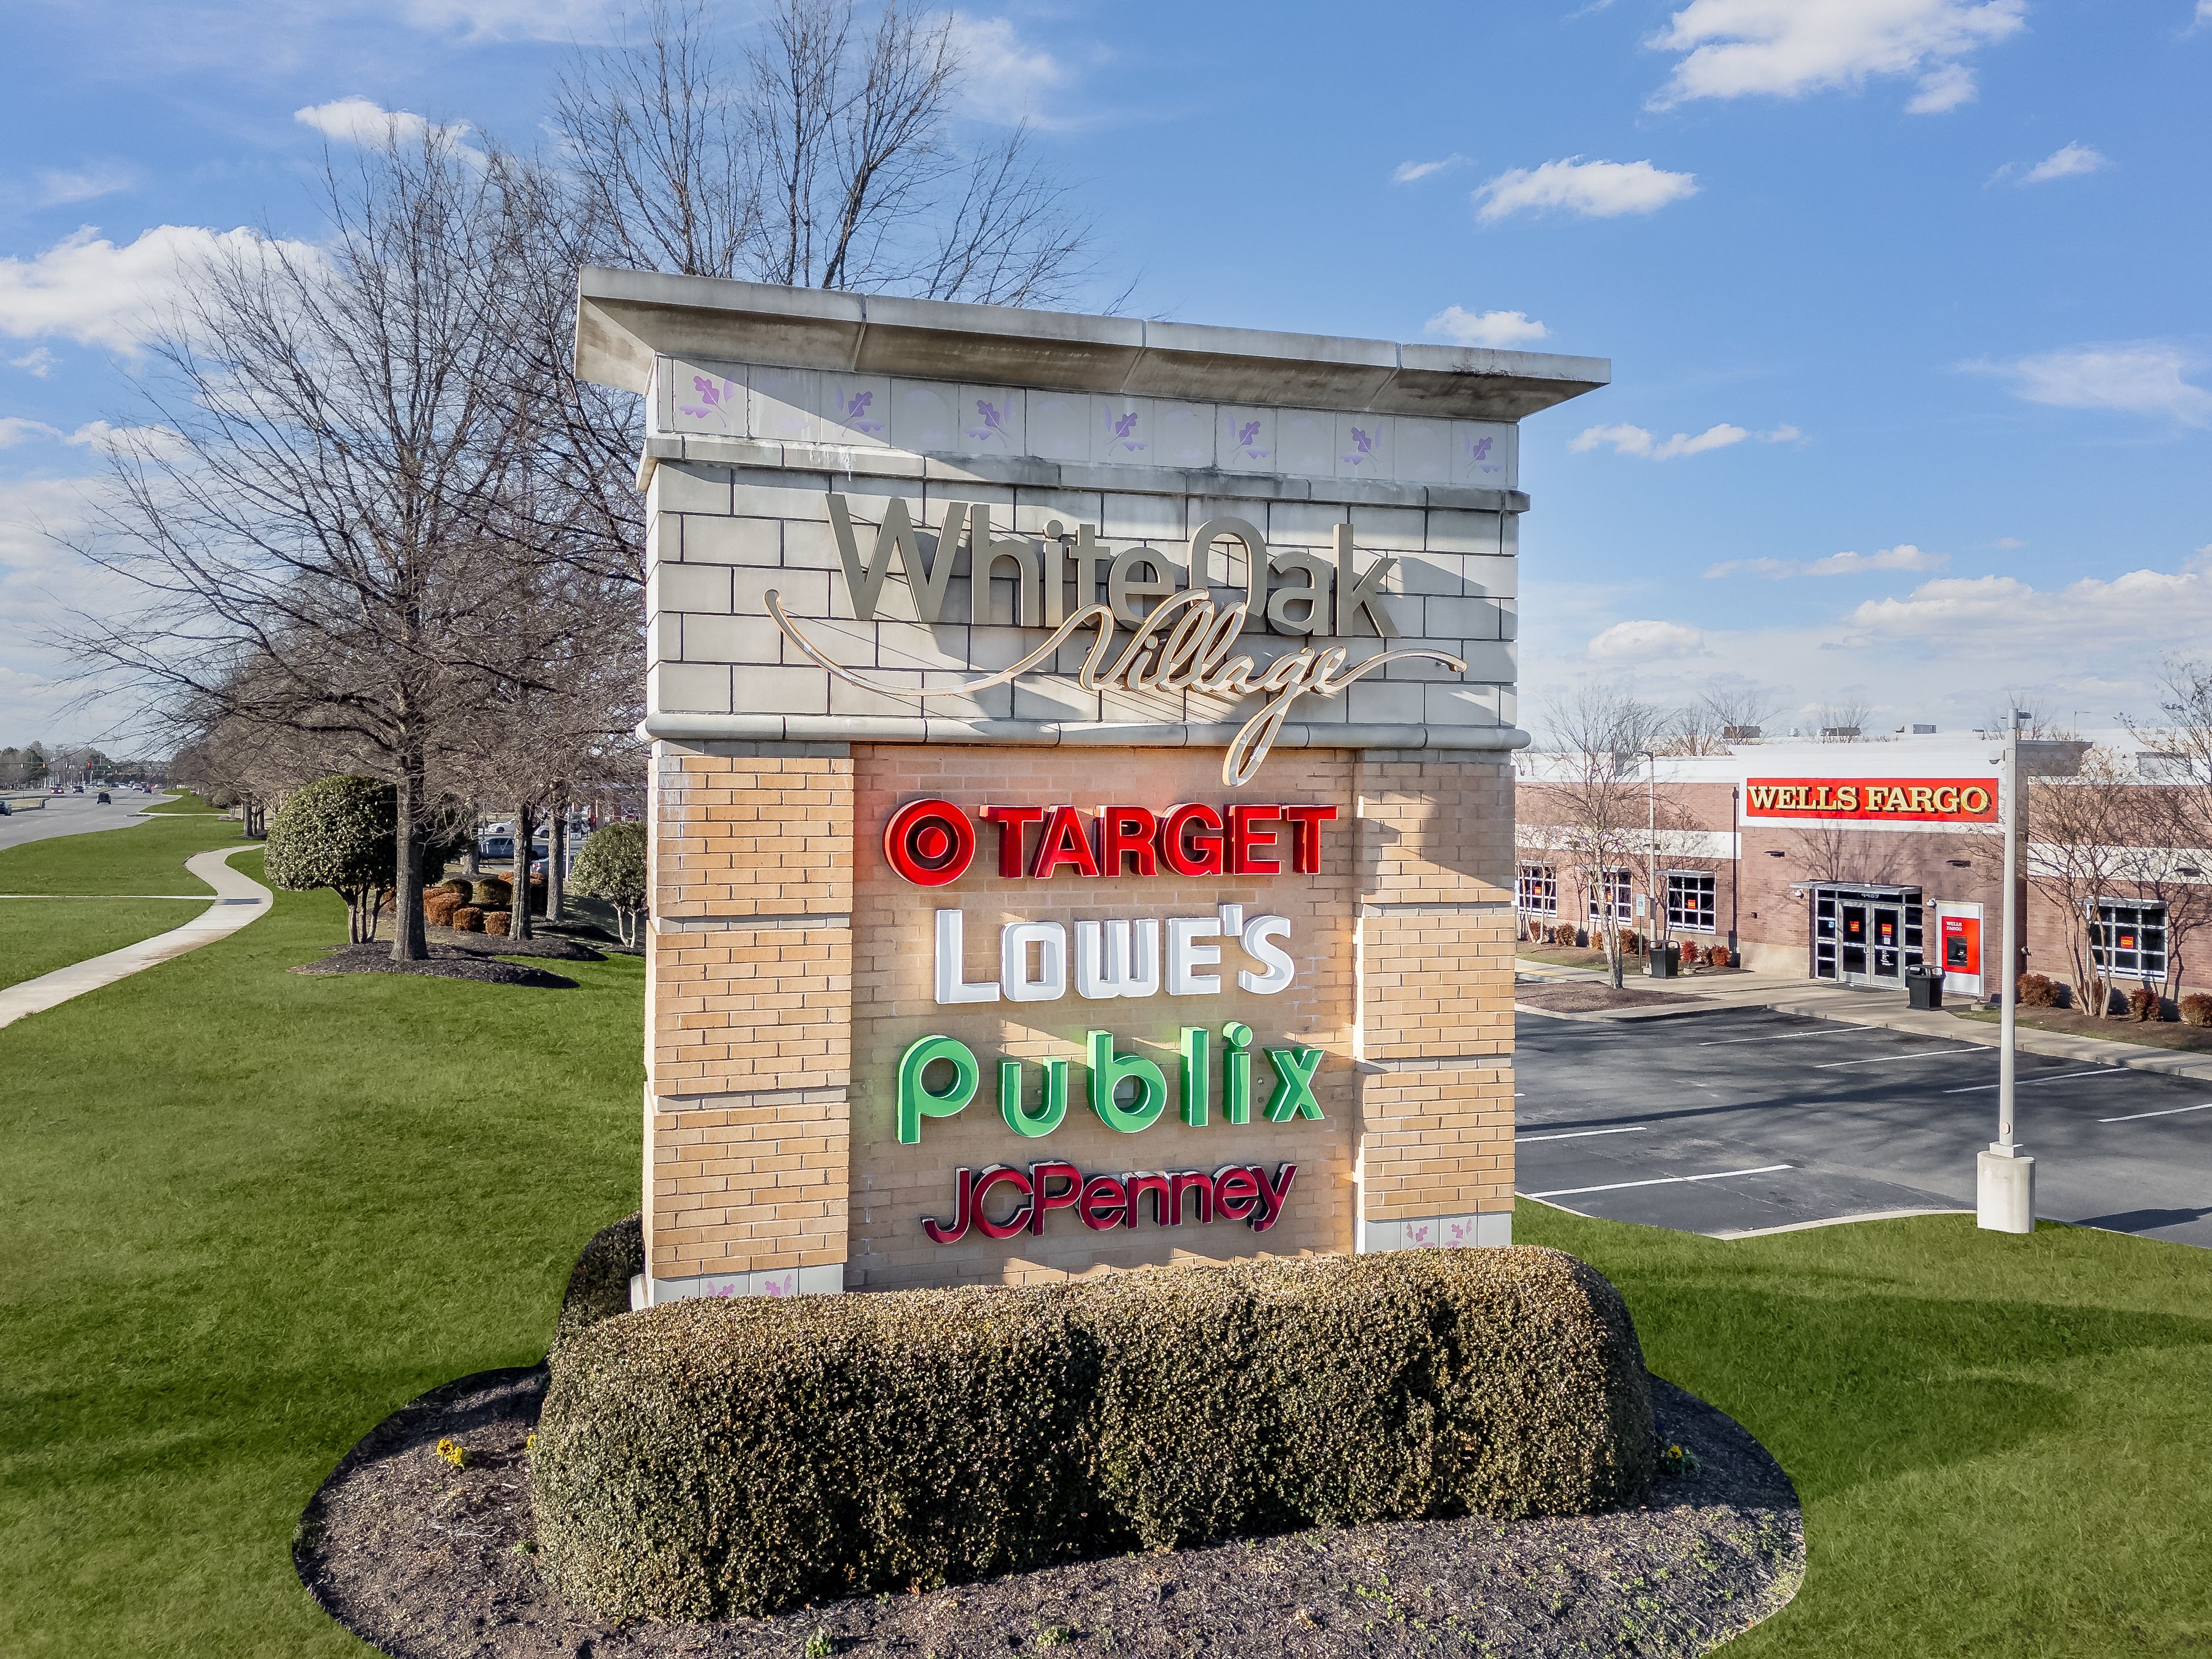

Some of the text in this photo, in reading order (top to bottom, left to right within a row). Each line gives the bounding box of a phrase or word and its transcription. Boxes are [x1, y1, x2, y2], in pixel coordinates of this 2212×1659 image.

[825, 493, 1399, 638] White Oak
[764, 587, 1467, 788] Village
[979, 803, 1339, 879] TARGET
[1748, 786, 1991, 815] WELLS FARGO
[935, 903, 1296, 1005] LOWE'S
[895, 1021, 1326, 1145] Publix
[920, 1159, 1298, 1244] JCPenney
